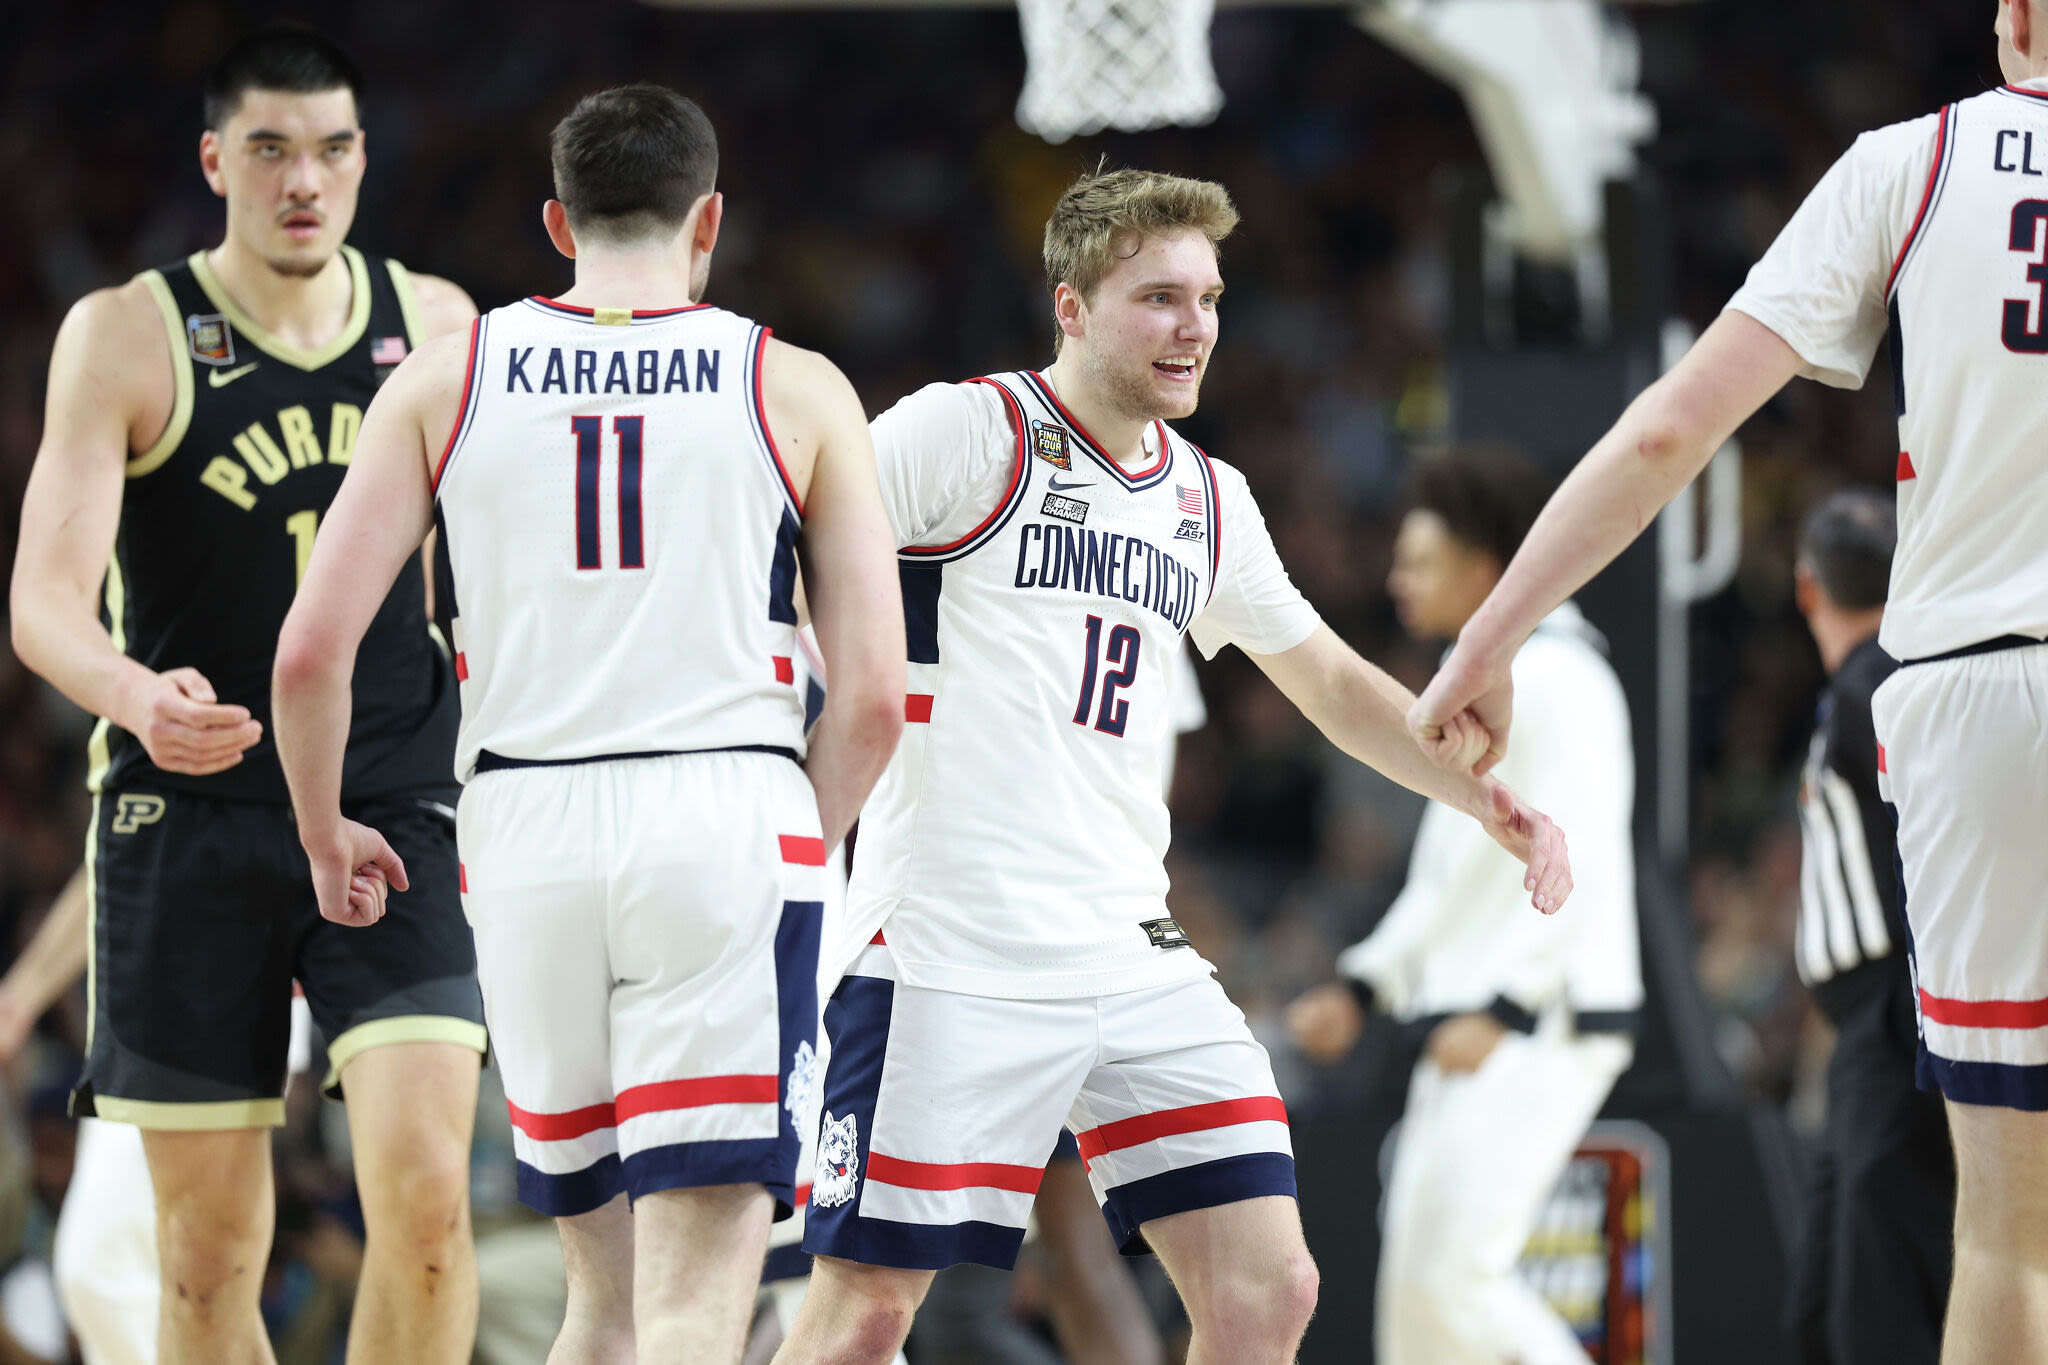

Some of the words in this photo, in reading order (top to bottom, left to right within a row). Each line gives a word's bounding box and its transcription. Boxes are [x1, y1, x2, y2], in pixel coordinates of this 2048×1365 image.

[1993, 130, 2048, 176] CL
[2001, 199, 2048, 354] 3
[506, 347, 720, 394] KARABAN
[200, 401, 363, 511] PURD
[1038, 429, 1062, 443] FINAL
[1039, 438, 1062, 451] FOUR
[571, 415, 645, 570] 11
[1043, 505, 1085, 522] CHANGE
[1175, 527, 1206, 540] EAST
[1180, 518, 1202, 530] BIG
[286, 510, 317, 592] 1
[1014, 523, 1199, 636] CONNECTICUT
[1072, 614, 1141, 738] 12
[111, 793, 166, 835] P
